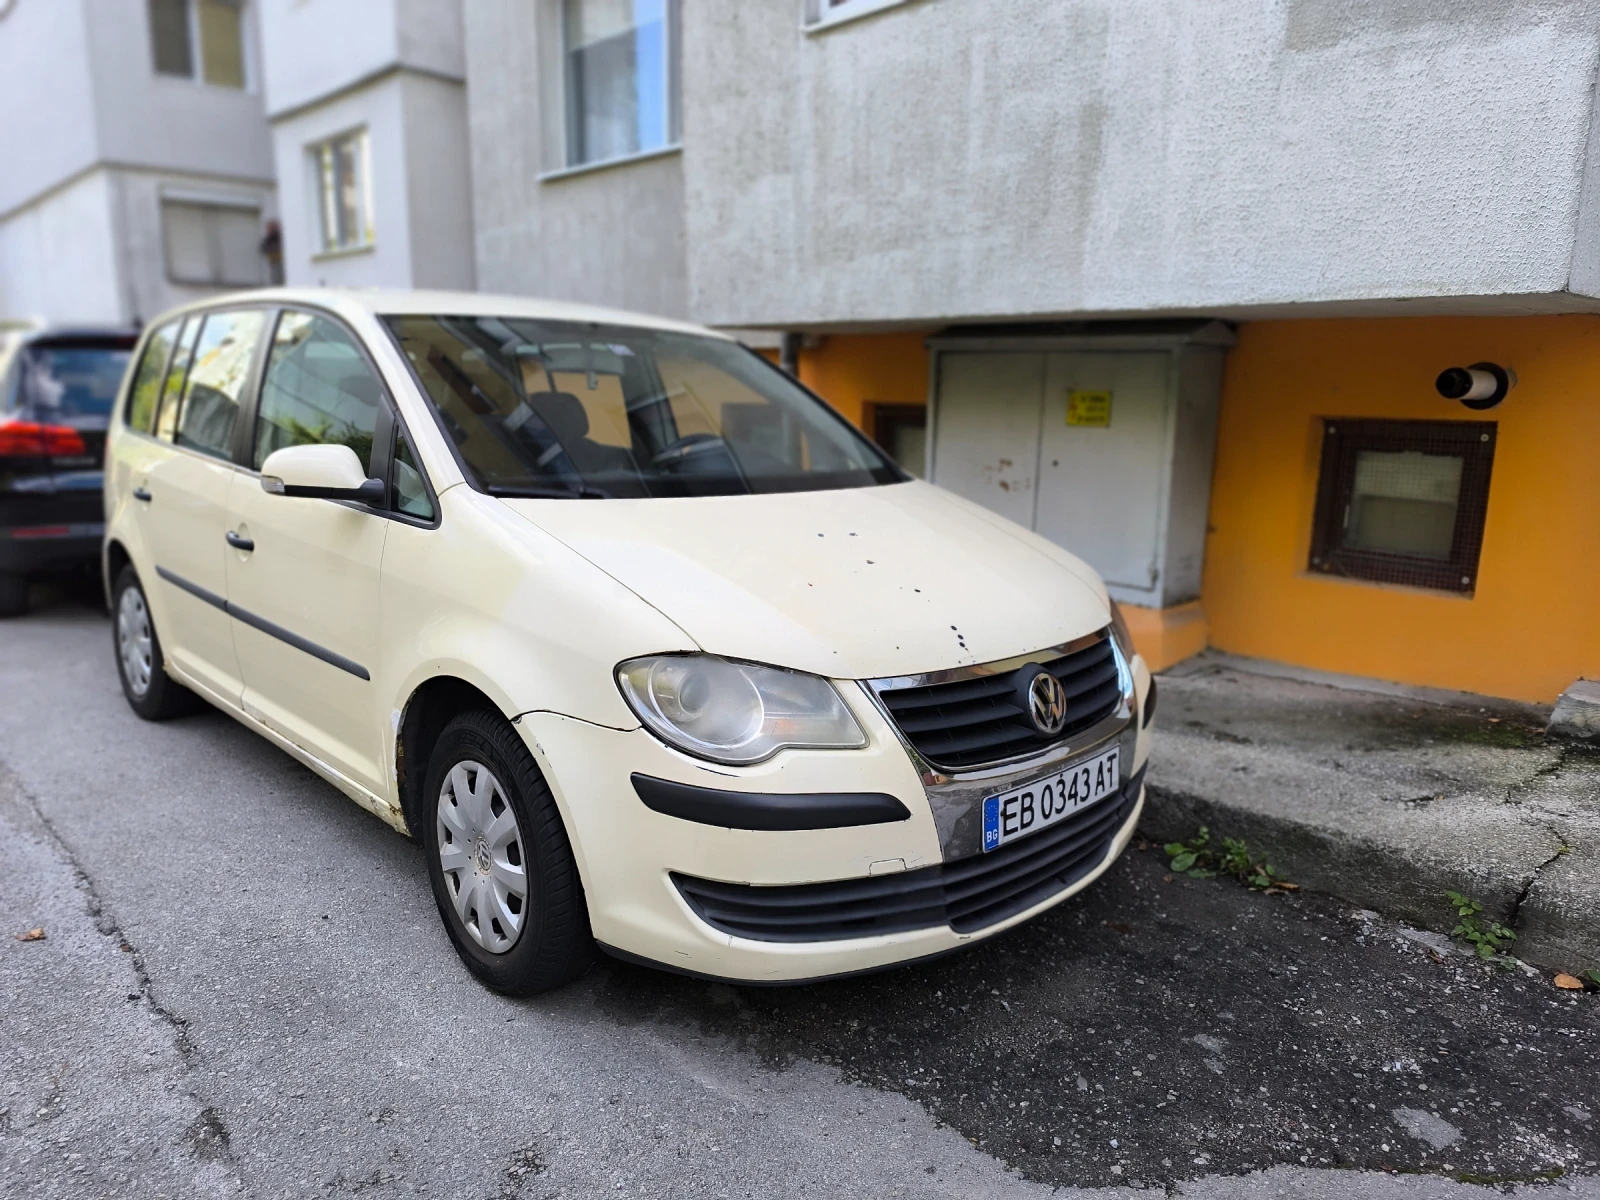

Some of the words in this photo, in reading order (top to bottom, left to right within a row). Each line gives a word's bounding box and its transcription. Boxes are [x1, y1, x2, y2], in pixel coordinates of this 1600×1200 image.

[1003, 791, 1035, 837] EB
[1041, 767, 1091, 820] 0343
[1094, 753, 1117, 796] AT
[986, 829, 998, 843] BG
